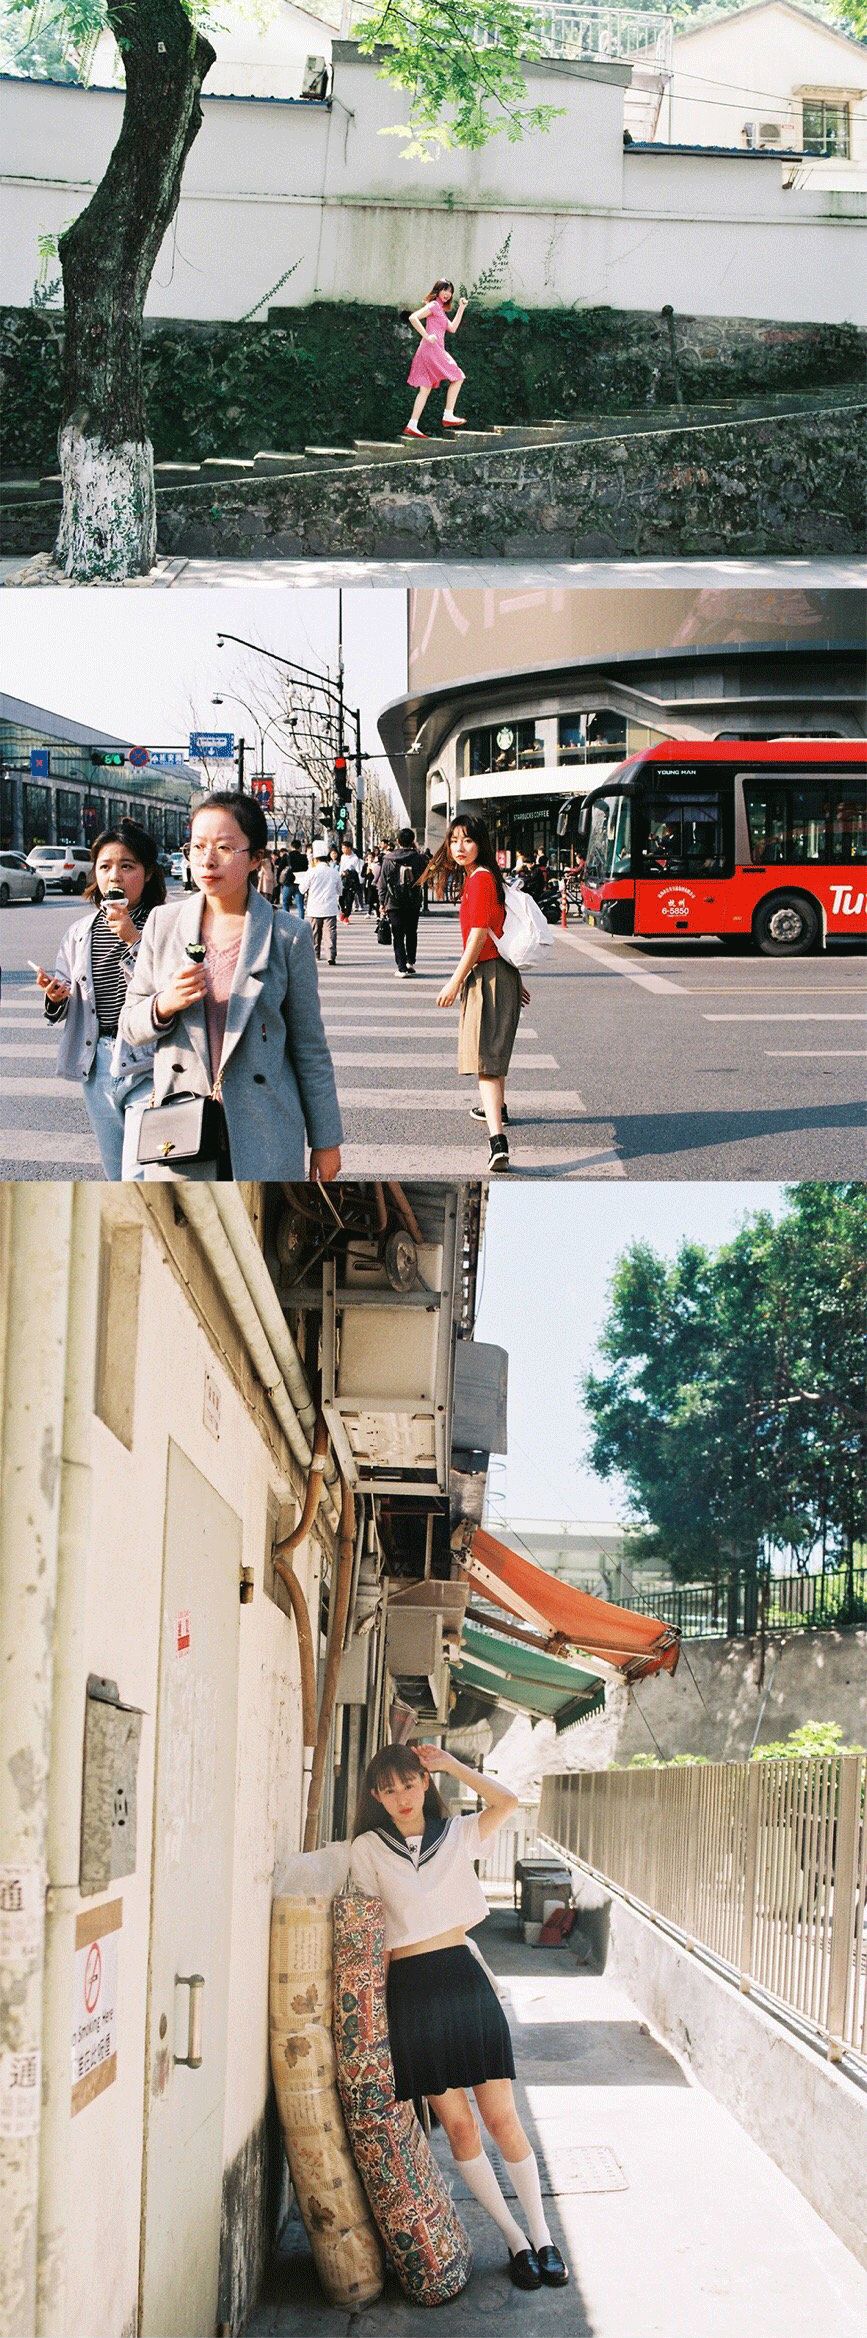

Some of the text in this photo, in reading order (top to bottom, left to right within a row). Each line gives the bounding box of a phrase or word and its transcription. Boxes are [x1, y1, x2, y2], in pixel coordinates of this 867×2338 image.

[513, 809, 550, 821] STARBUCKS COFFEE
[829, 885, 867, 915] Tu
[661, 907, 690, 915] 6-5850
[78, 2016, 100, 2043] Smoking
[102, 2008, 114, 2026] Here
